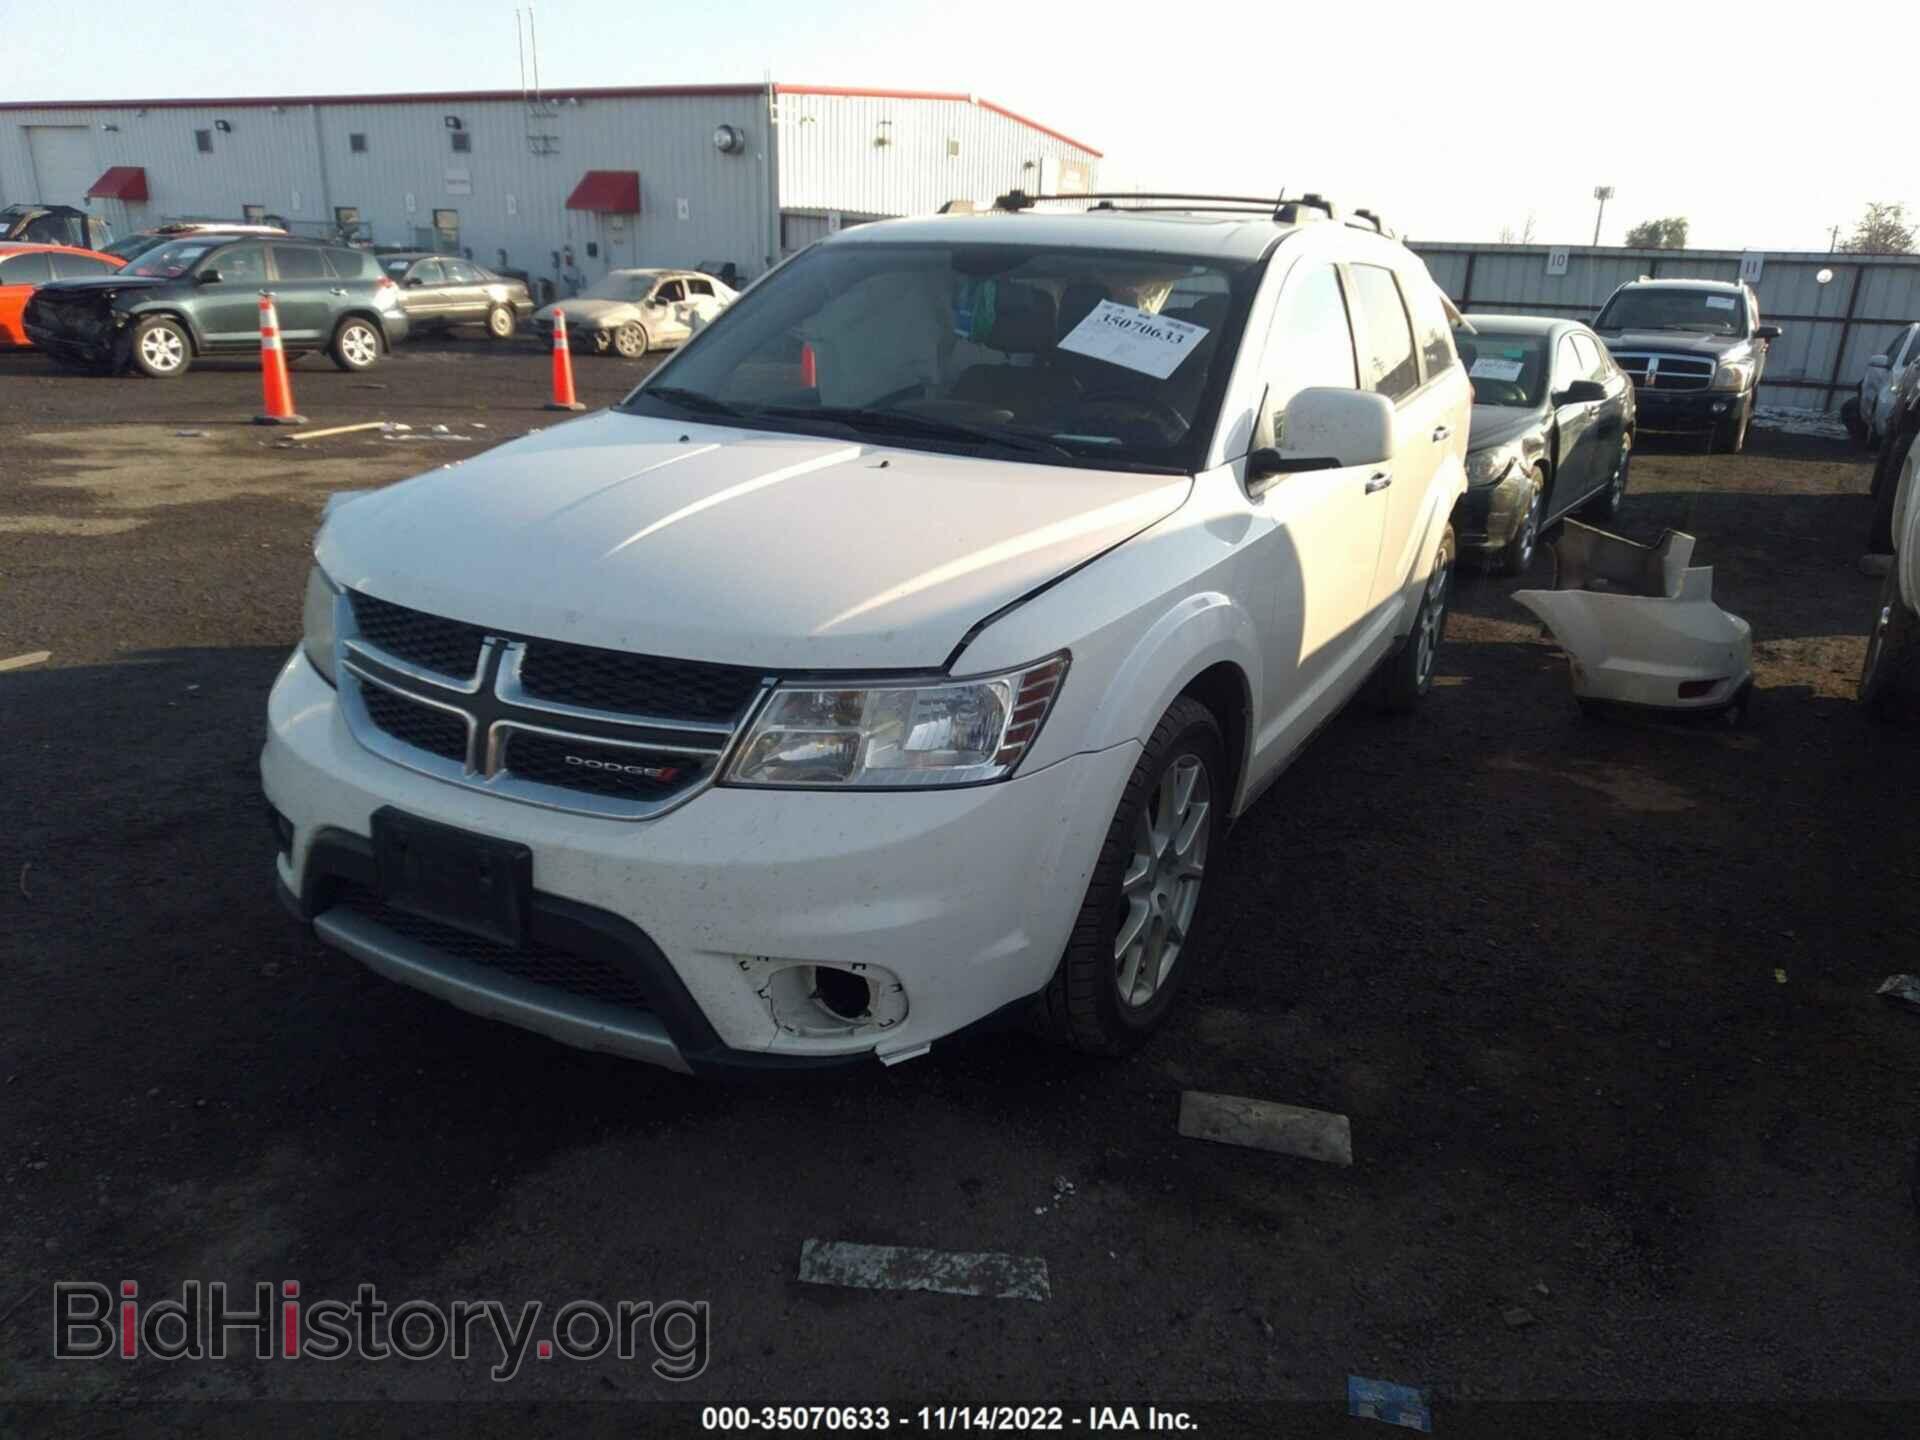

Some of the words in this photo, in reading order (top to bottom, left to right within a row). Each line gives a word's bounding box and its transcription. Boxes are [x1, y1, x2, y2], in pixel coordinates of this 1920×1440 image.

[1551, 253, 1566, 267] 10
[1745, 260, 1757, 274] 11
[1102, 313, 1185, 345] 35070633
[565, 755, 662, 777] DODGE
